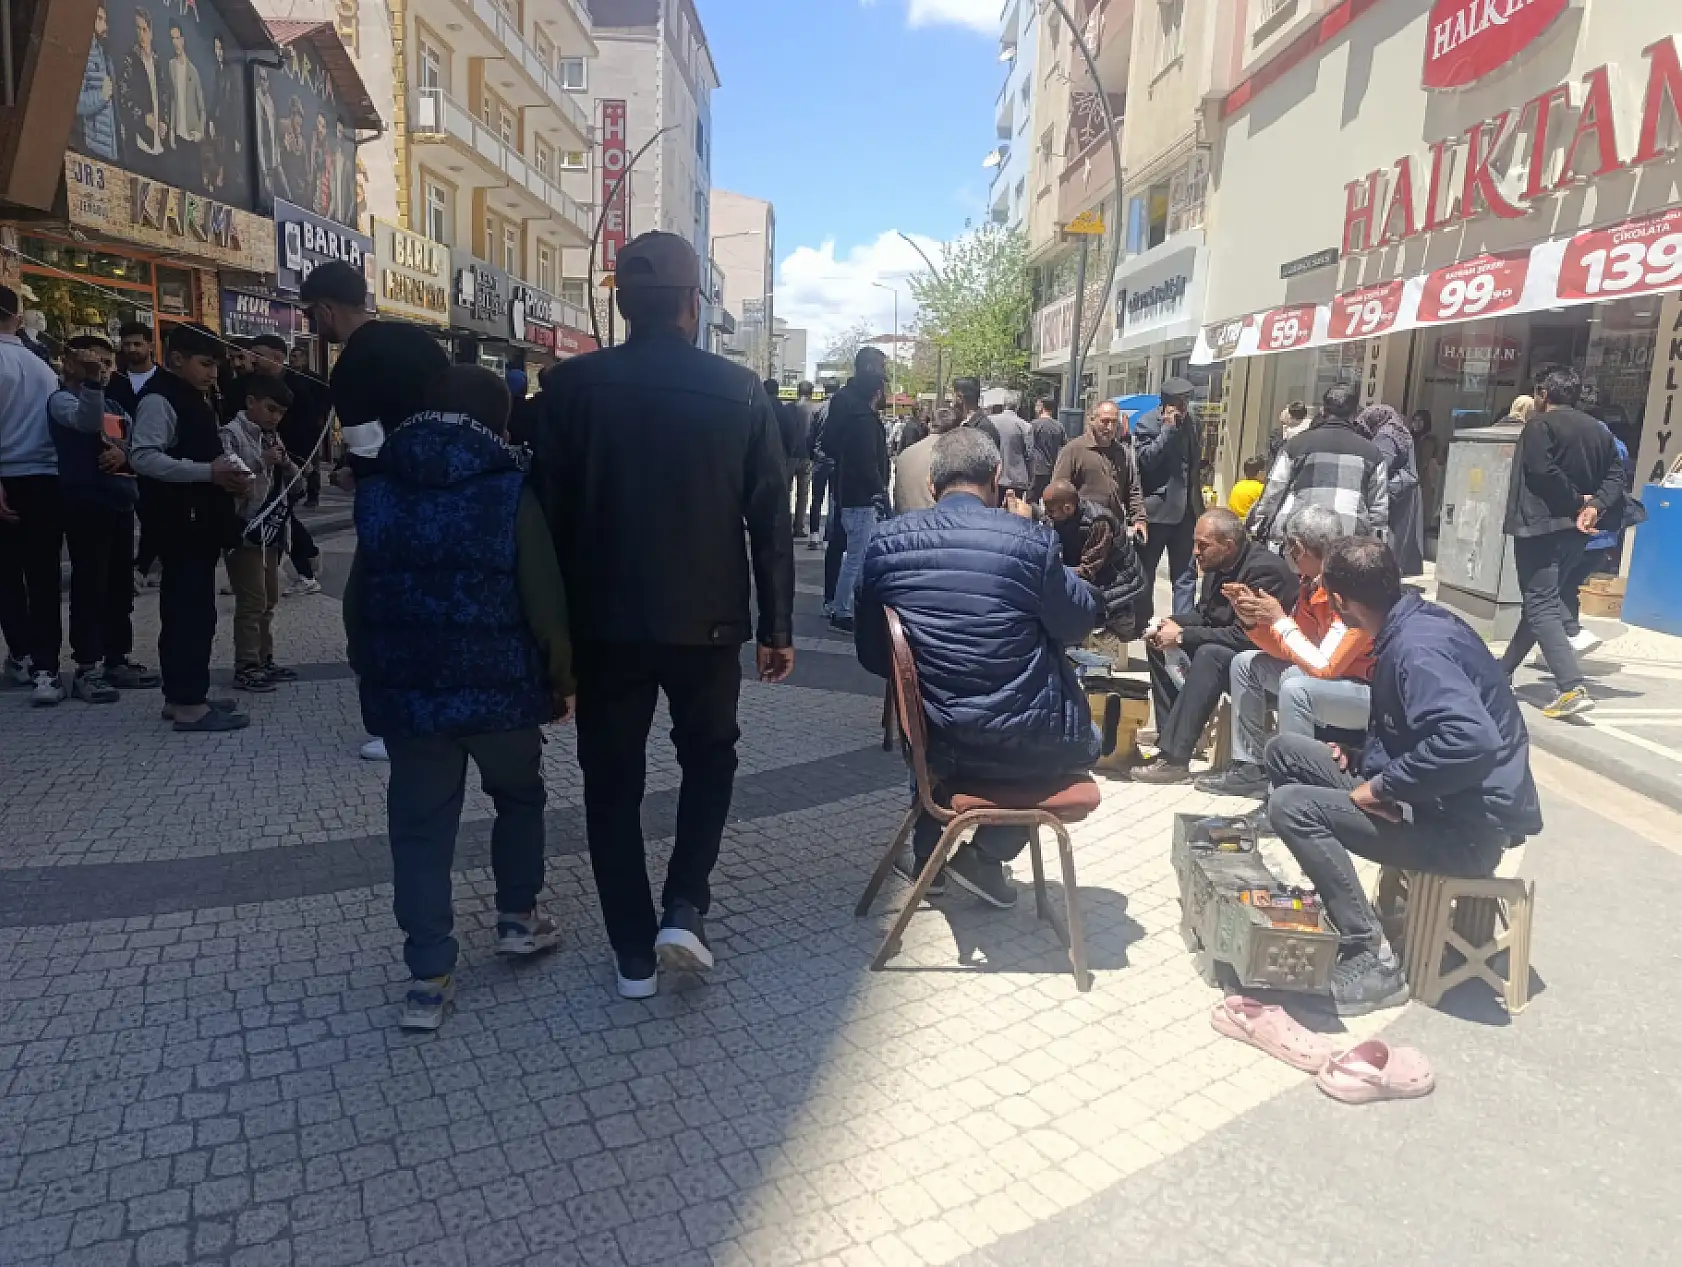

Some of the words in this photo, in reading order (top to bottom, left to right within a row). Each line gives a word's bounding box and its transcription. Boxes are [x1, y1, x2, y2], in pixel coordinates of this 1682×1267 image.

[1431, 0, 1535, 61] HALK
[1340, 33, 1682, 259] HALKTAN
[603, 117, 623, 264] HOTEL
[303, 221, 362, 267] BARLA
[1579, 232, 1682, 295] 139
[1345, 300, 1382, 337] 79
[1438, 274, 1495, 319] 99
[1270, 318, 1299, 348] 59
